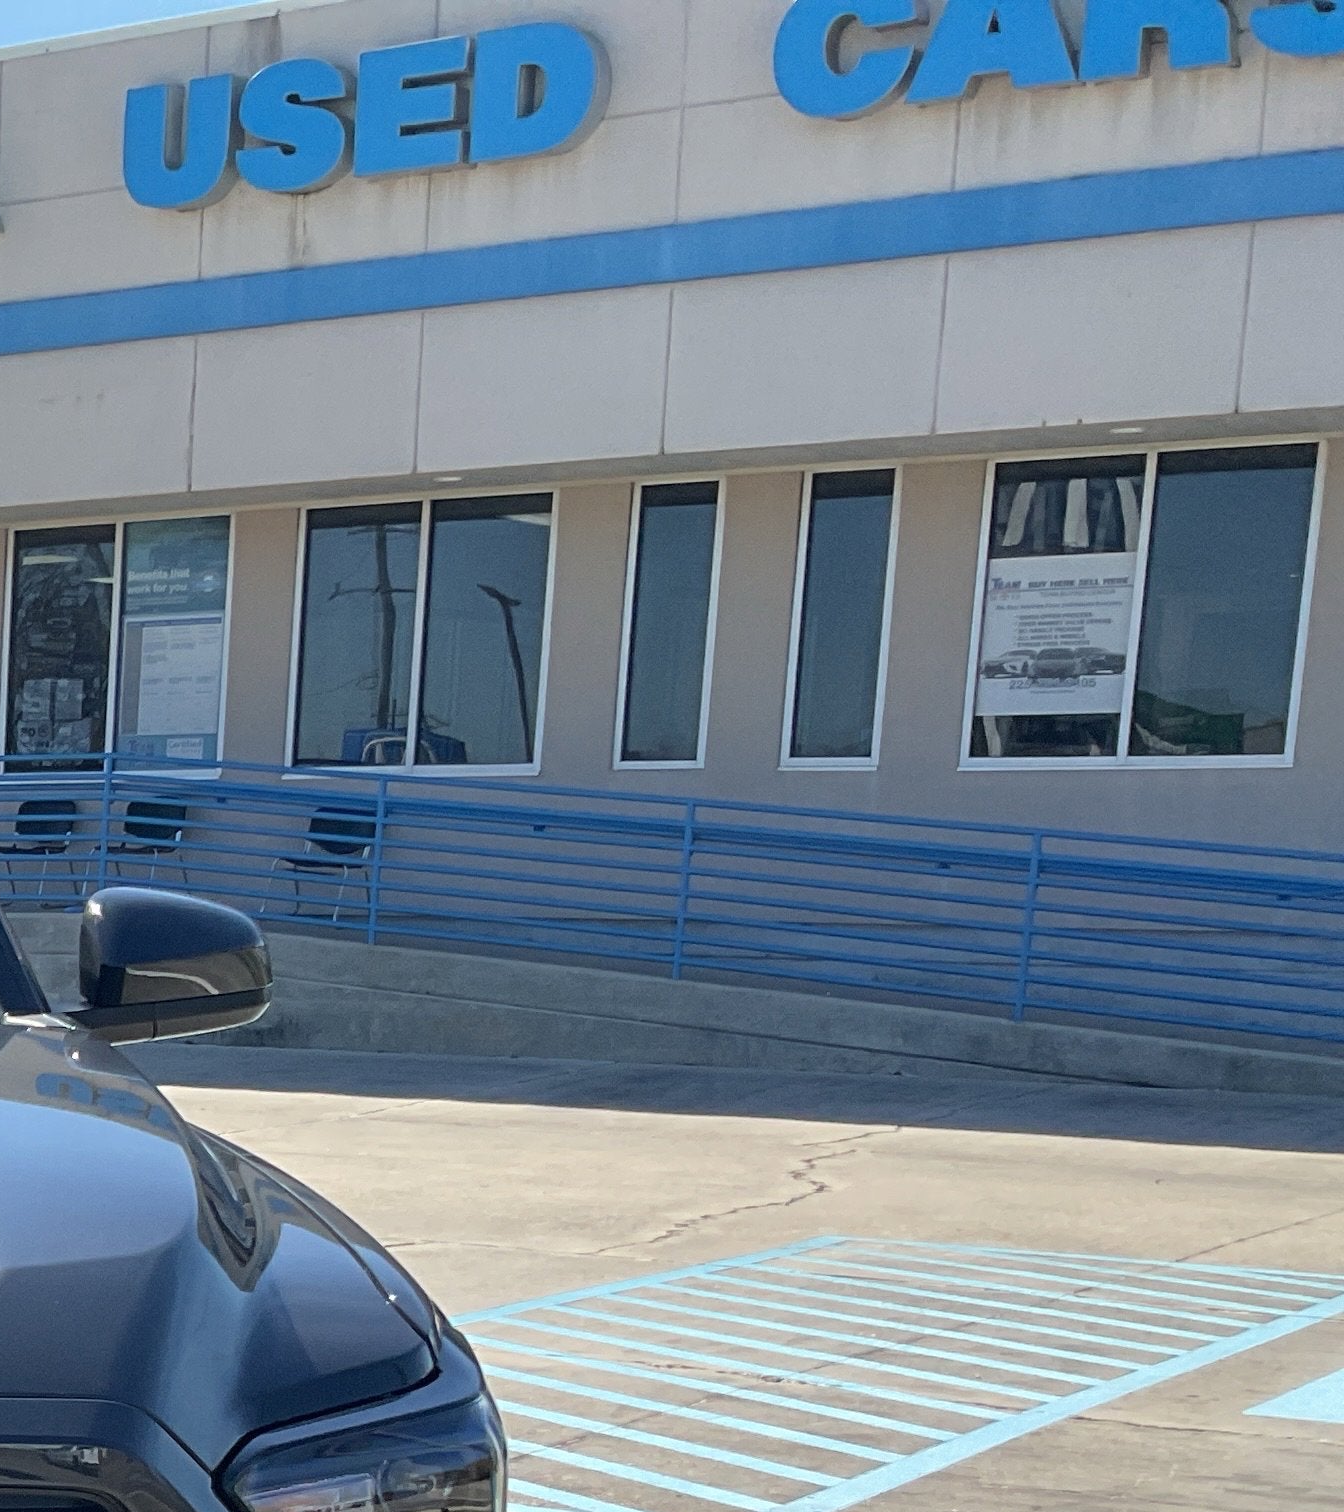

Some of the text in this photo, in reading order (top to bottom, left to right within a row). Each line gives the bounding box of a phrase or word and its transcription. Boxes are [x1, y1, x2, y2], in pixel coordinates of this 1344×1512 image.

[123, 21, 597, 208] USED
[127, 569, 169, 581] Benefits
[152, 582, 168, 593] for
[1028, 580, 1049, 589] BUY
